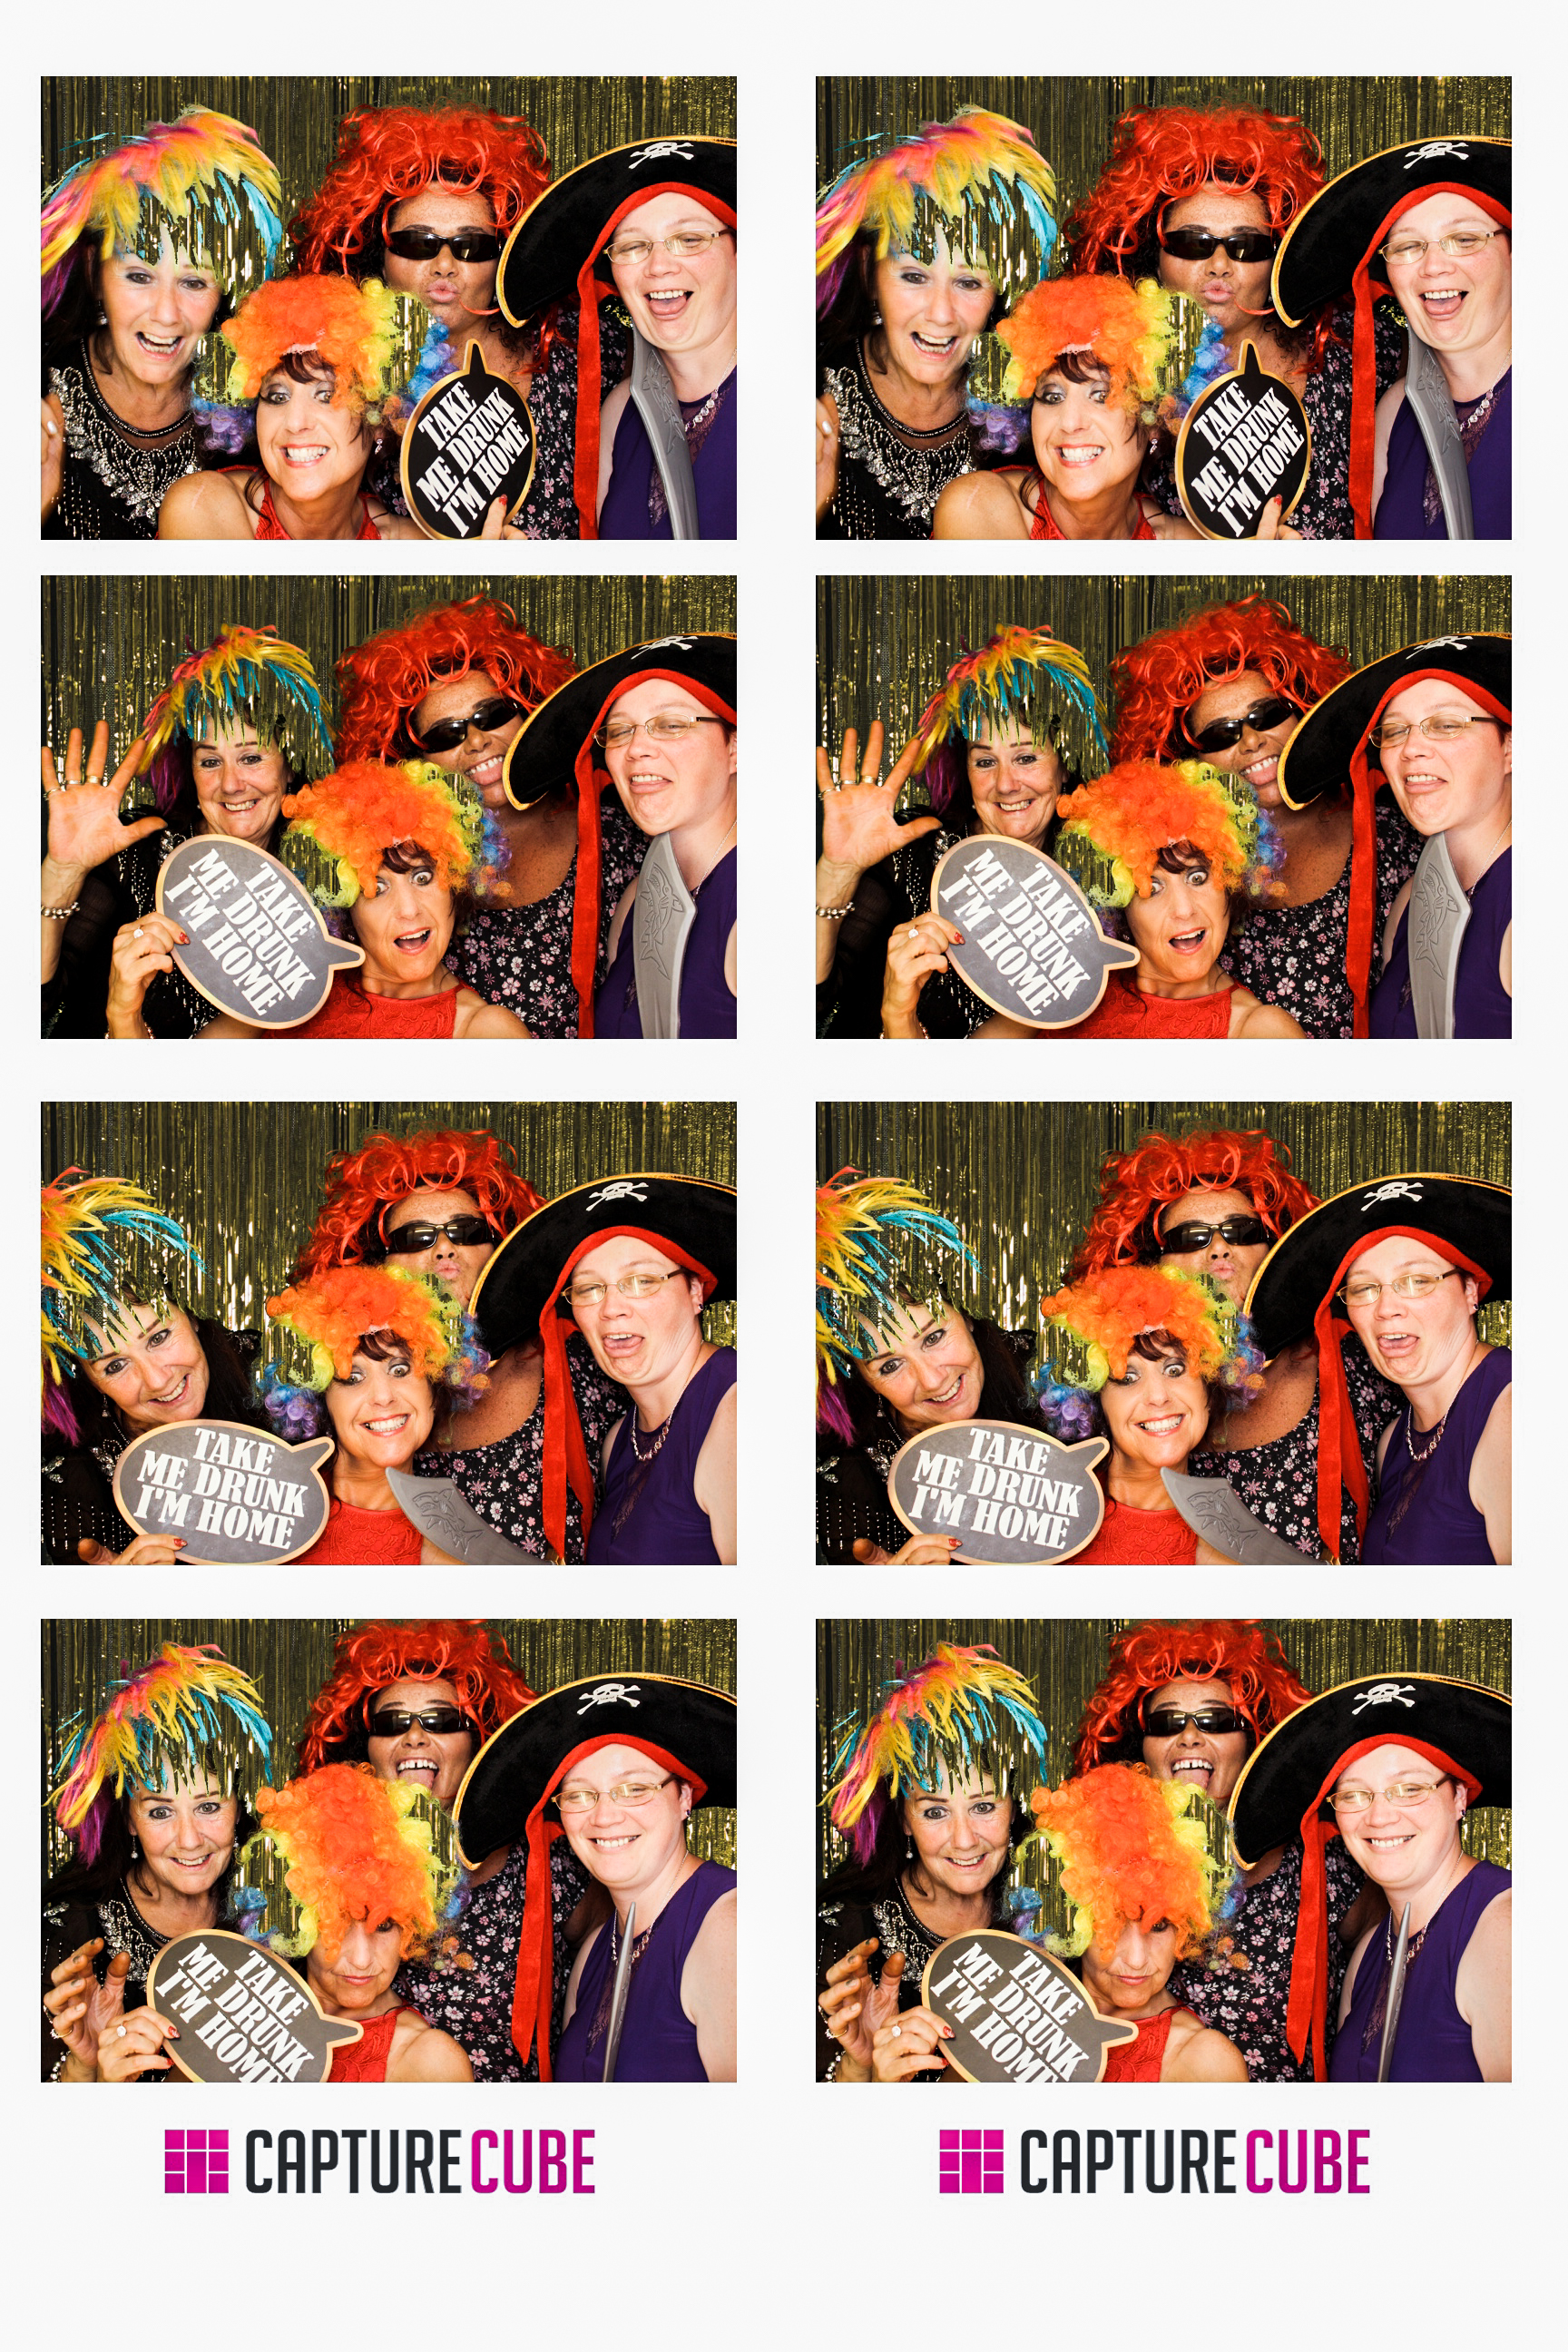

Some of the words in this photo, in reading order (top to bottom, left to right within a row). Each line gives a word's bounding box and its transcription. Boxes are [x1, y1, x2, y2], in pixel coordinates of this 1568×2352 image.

[416, 456, 459, 512] ME
[446, 387, 514, 475] DRUNK
[418, 381, 477, 451] TAKE
[1191, 456, 1234, 512] ME
[1220, 387, 1289, 475] DRUNK
[1193, 381, 1252, 451] TAKE
[442, 477, 486, 537] I'M
[473, 416, 530, 495] HOME
[1217, 477, 1261, 537] I'M
[1248, 416, 1305, 495] HOME
[189, 848, 239, 900] ME
[222, 892, 316, 1000] DRUNK
[244, 862, 316, 944] TAKE
[964, 848, 1014, 900] ME
[997, 892, 1091, 1000] DRUNK
[1019, 862, 1091, 944] TAKE
[164, 874, 220, 932] I'M
[201, 922, 284, 1016] HOME
[939, 874, 995, 932] I'M
[976, 922, 1059, 1016] HOME
[137, 1450, 188, 1490] ME
[192, 1463, 308, 1517] DRUNK
[193, 1427, 275, 1475] TAKE
[912, 1450, 963, 1490] ME
[967, 1463, 1083, 1517] DRUNK
[968, 1427, 1050, 1475] TAKE
[133, 1485, 192, 1527] I'M
[195, 1498, 295, 1549] HOME
[908, 1485, 967, 1527] I'M
[970, 1498, 1070, 1549] HOME
[155, 1968, 211, 2024] I'M
[178, 1942, 229, 1992] ME
[214, 1979, 314, 2082] DRUNK
[234, 1950, 309, 2024] TAKE
[930, 1968, 986, 2024] I'M
[953, 1942, 1004, 1992] ME
[989, 1979, 1089, 2082] DRUNK
[1009, 1950, 1083, 2024] TAKE
